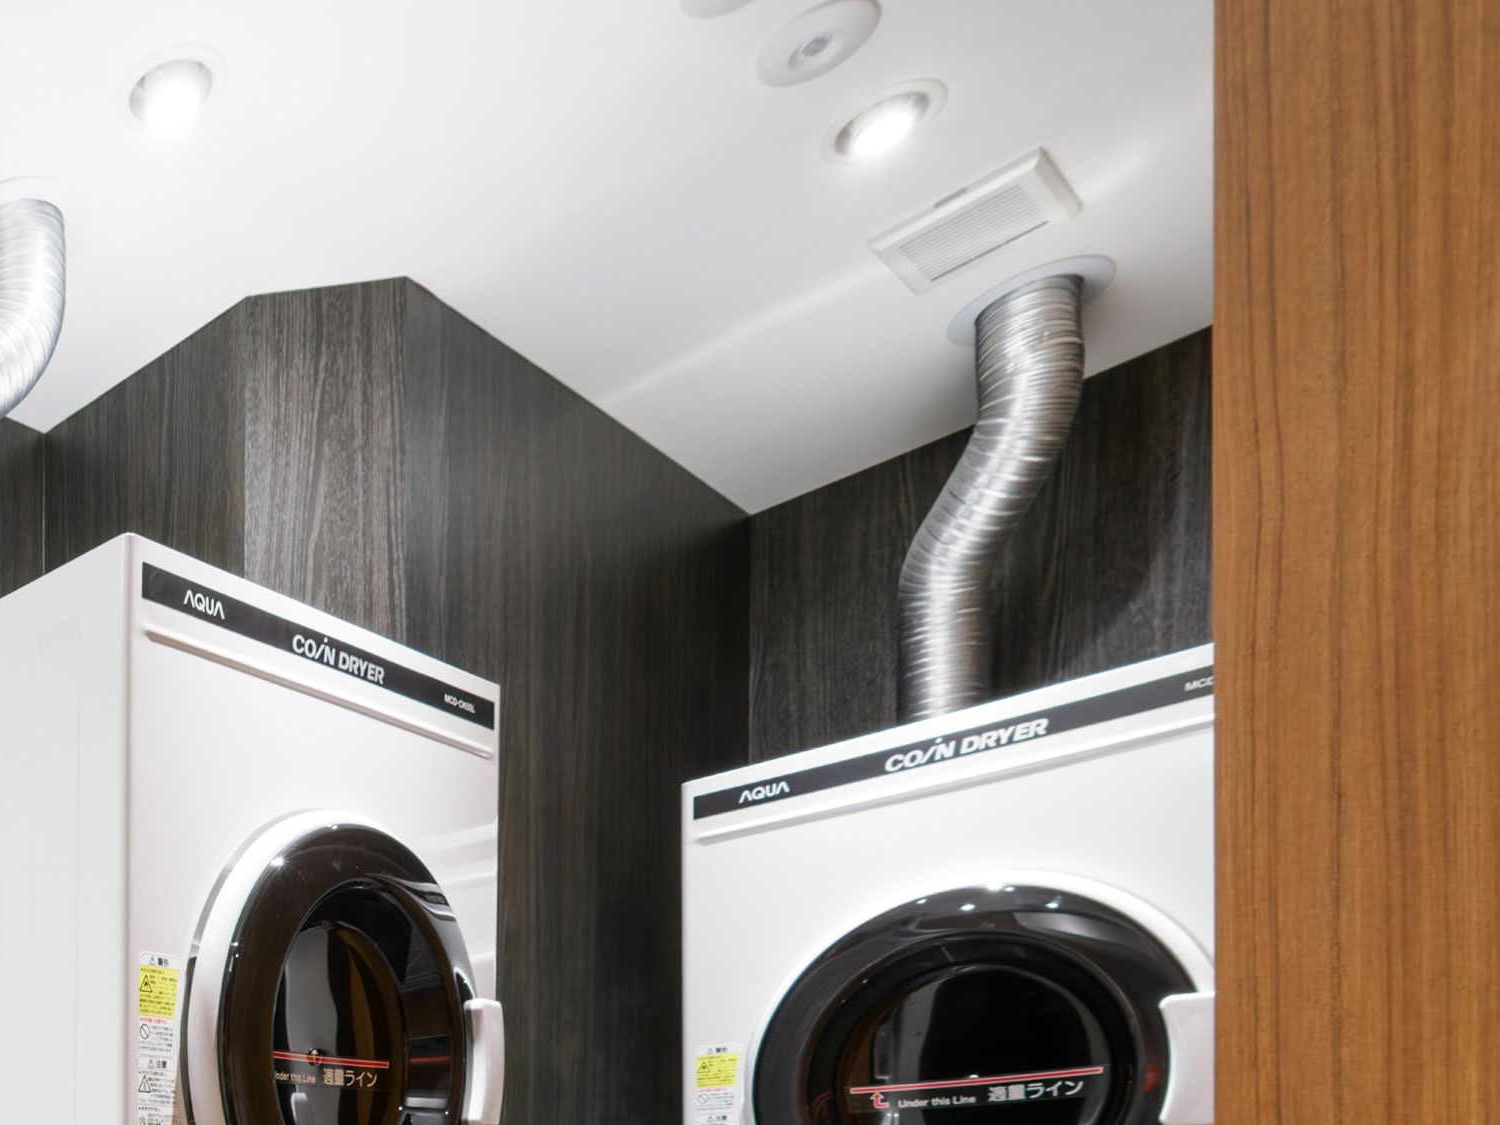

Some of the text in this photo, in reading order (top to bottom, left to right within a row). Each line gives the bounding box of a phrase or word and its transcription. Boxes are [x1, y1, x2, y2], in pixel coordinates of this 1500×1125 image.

[184, 589, 225, 620] AQUA
[293, 635, 385, 685] COIN DRYER
[884, 718, 1049, 773] COIN DRYER
[738, 781, 790, 803] AQUA
[323, 1068, 378, 1088] 適量ライン
[898, 1081, 1084, 1108] Under this Line 適量ライン
